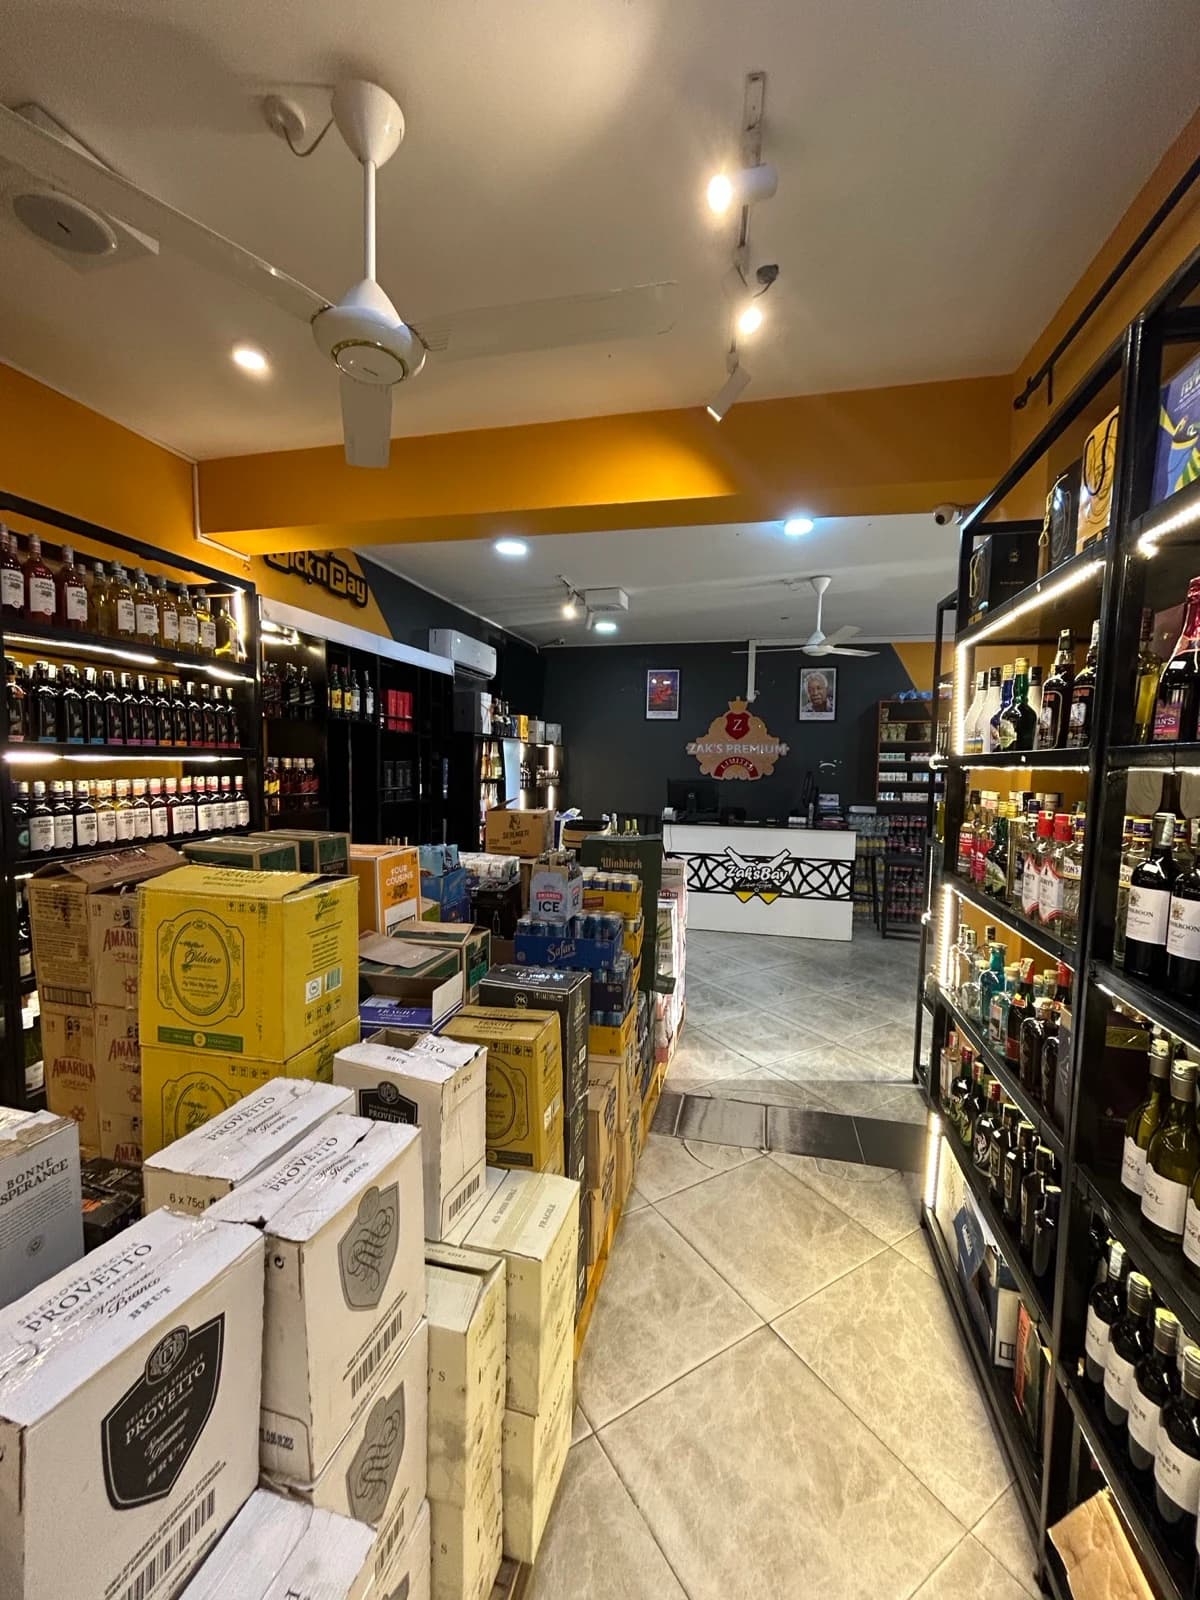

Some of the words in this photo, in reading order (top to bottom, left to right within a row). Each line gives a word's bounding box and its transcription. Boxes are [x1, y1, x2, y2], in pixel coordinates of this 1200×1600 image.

[732, 719, 742, 731] Z
[688, 743, 723, 754] ZAK'S
[726, 744, 786, 755] PREMIUM
[538, 901, 560, 913] ICE
[546, 940, 577, 963] Safari
[52, 1058, 97, 1083] AMARULA
[207, 1096, 276, 1141] PROVETTO
[6, 1157, 53, 1190] BONNE
[269, 1137, 338, 1192] PROVETTO
[169, 1193, 176, 1203] 6
[178, 1196, 184, 1205] x
[186, 1194, 205, 1209] 75cl
[25, 1244, 152, 1333] PROVETTO
[108, 1277, 161, 1319] Bianco
[129, 1285, 172, 1320] BRUT
[125, 1361, 206, 1446] PROVETTO
